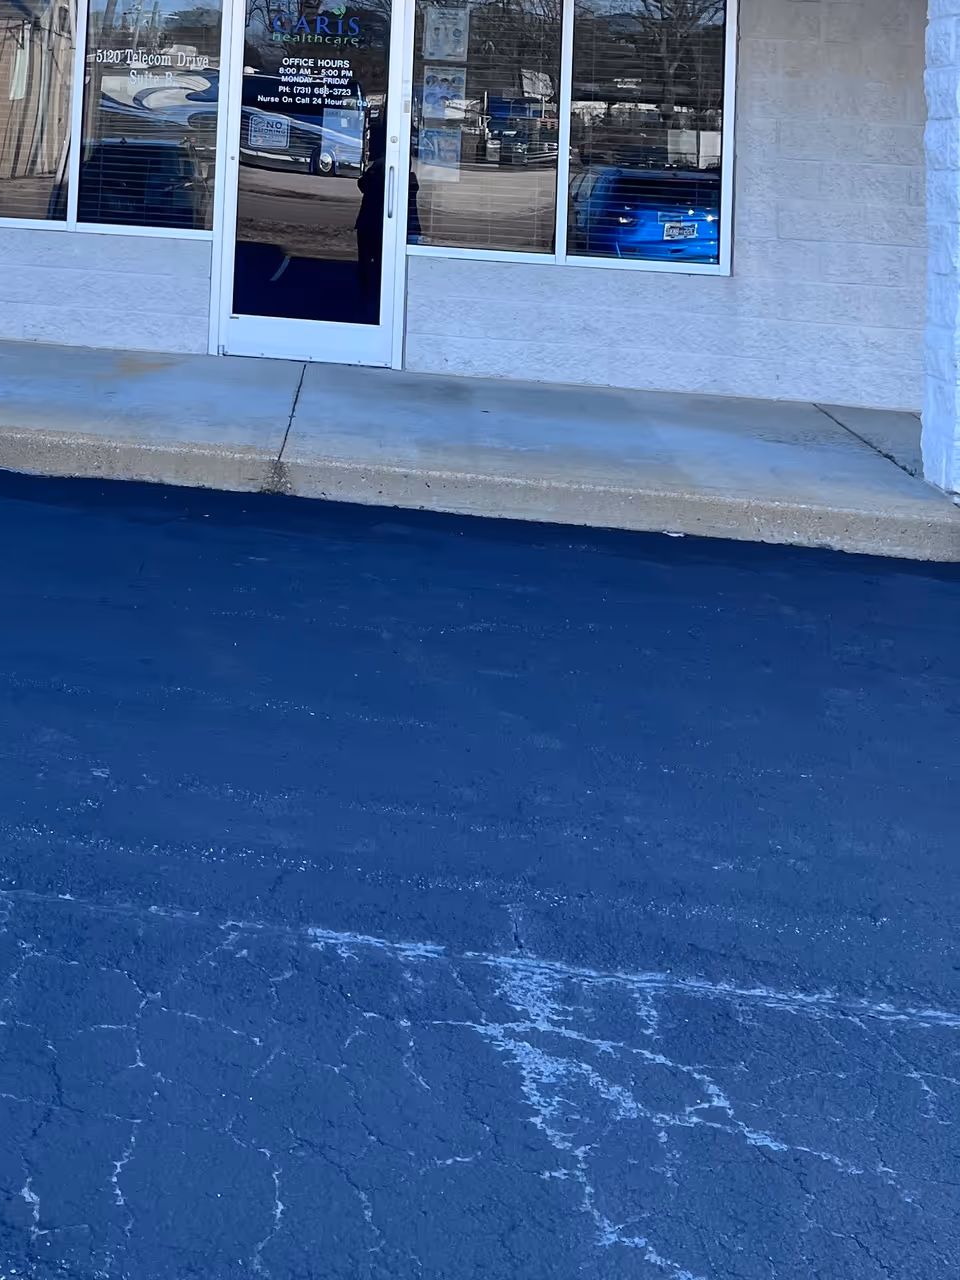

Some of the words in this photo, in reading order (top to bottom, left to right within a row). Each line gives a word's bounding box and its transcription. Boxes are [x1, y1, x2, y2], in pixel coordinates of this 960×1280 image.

[272, 14, 360, 36] CARIS
[272, 32, 360, 46] healthcare
[96, 49, 121, 63] 5120
[125, 50, 172, 66] Telecom
[176, 52, 209, 67] Drive
[282, 57, 315, 67] OFFICE
[317, 59, 350, 68] HOURS
[130, 69, 160, 85] Suite
[293, 86, 311, 94] (731)
[257, 95, 279, 103] Nurse
[295, 96, 310, 104] Call
[312, 97, 322, 105] 24
[324, 98, 347, 106] Hours
[357, 99, 372, 108] Day
[266, 121, 283, 130] NO
